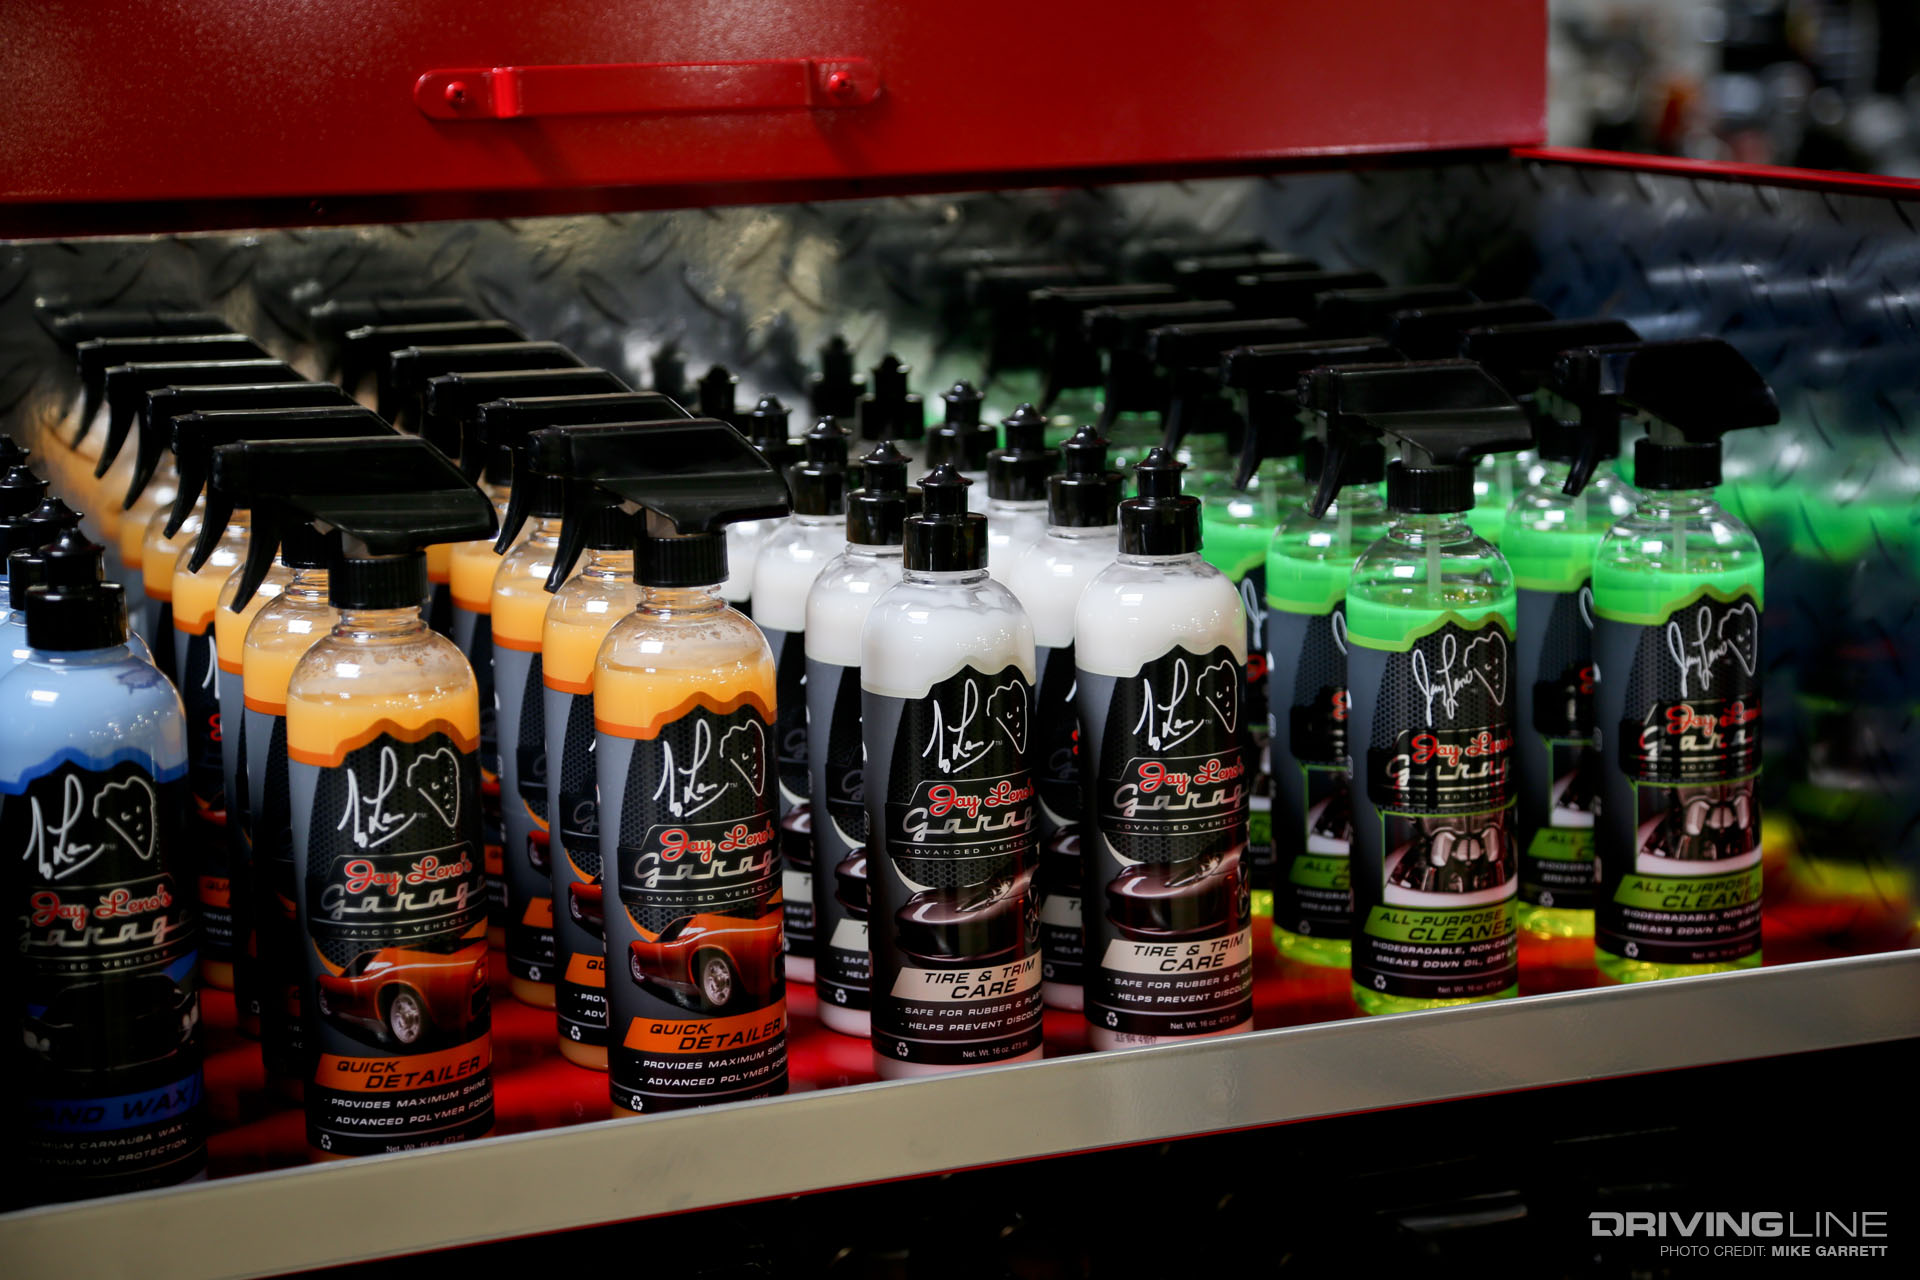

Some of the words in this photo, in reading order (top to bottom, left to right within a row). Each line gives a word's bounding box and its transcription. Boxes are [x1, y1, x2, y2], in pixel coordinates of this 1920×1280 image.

[1411, 733, 1463, 766] Jay
[1138, 761, 1191, 796] Jay
[1193, 754, 1245, 785] Leno's
[928, 784, 982, 819] Jay
[984, 776, 1035, 807] Leno's
[1113, 784, 1247, 818] Garag
[902, 805, 1036, 842] Garag
[659, 828, 716, 864] Jay
[718, 819, 775, 852] Leno's
[905, 847, 980, 855] ADVANCED
[344, 859, 402, 896] Jay
[405, 850, 473, 885] Leno's
[634, 850, 780, 888] Garag
[30, 890, 88, 931] Jay
[92, 882, 175, 920] Leno's
[1380, 908, 1504, 926] ALL-PURPOSE
[1409, 917, 1512, 941] CLEANER
[1134, 945, 1178, 956] TIRE
[1186, 944, 1200, 955] &
[1211, 933, 1244, 952] TRIM
[925, 972, 970, 984] TIRE
[978, 971, 992, 982] &
[1002, 958, 1036, 978] TRIM
[1159, 953, 1226, 972] CARE
[1376, 954, 1419, 968] BREAKS
[1422, 959, 1460, 969] DOWN
[951, 978, 1018, 999] CARE
[1114, 978, 1143, 988] SAFE
[1147, 981, 1171, 989] FOR
[1175, 977, 1220, 989] RUBBER
[1117, 992, 1152, 1003] HELPS
[1157, 992, 1211, 1003] PREVENT
[905, 1007, 934, 1016] SAFE
[968, 1003, 1012, 1016] RUBBER
[650, 1023, 712, 1035] QUICK
[678, 1018, 781, 1050] DETAILER
[908, 1022, 944, 1031] HELPS
[949, 1020, 1003, 1031] PREVENT
[643, 1060, 703, 1070] PROVIDES
[708, 1051, 765, 1069] MAXIMUM
[962, 1050, 977, 1058] Net.
[979, 1048, 990, 1057] Wt.
[993, 1047, 1001, 1055] 16
[337, 1061, 400, 1073] QUICK
[365, 1056, 481, 1089] DETAILER
[647, 1077, 715, 1087] ADVANCED
[720, 1066, 769, 1083] POLYMER
[124, 1086, 190, 1119] WAX
[331, 1098, 391, 1109] PROVIDES
[396, 1090, 459, 1108] MAXIMUM
[463, 1077, 487, 1095] SHINE
[336, 1115, 404, 1126] ADVANCED
[409, 1106, 464, 1124] POLYMER
[157, 1122, 183, 1138] WAX
[117, 1137, 188, 1162] PROTECTION
